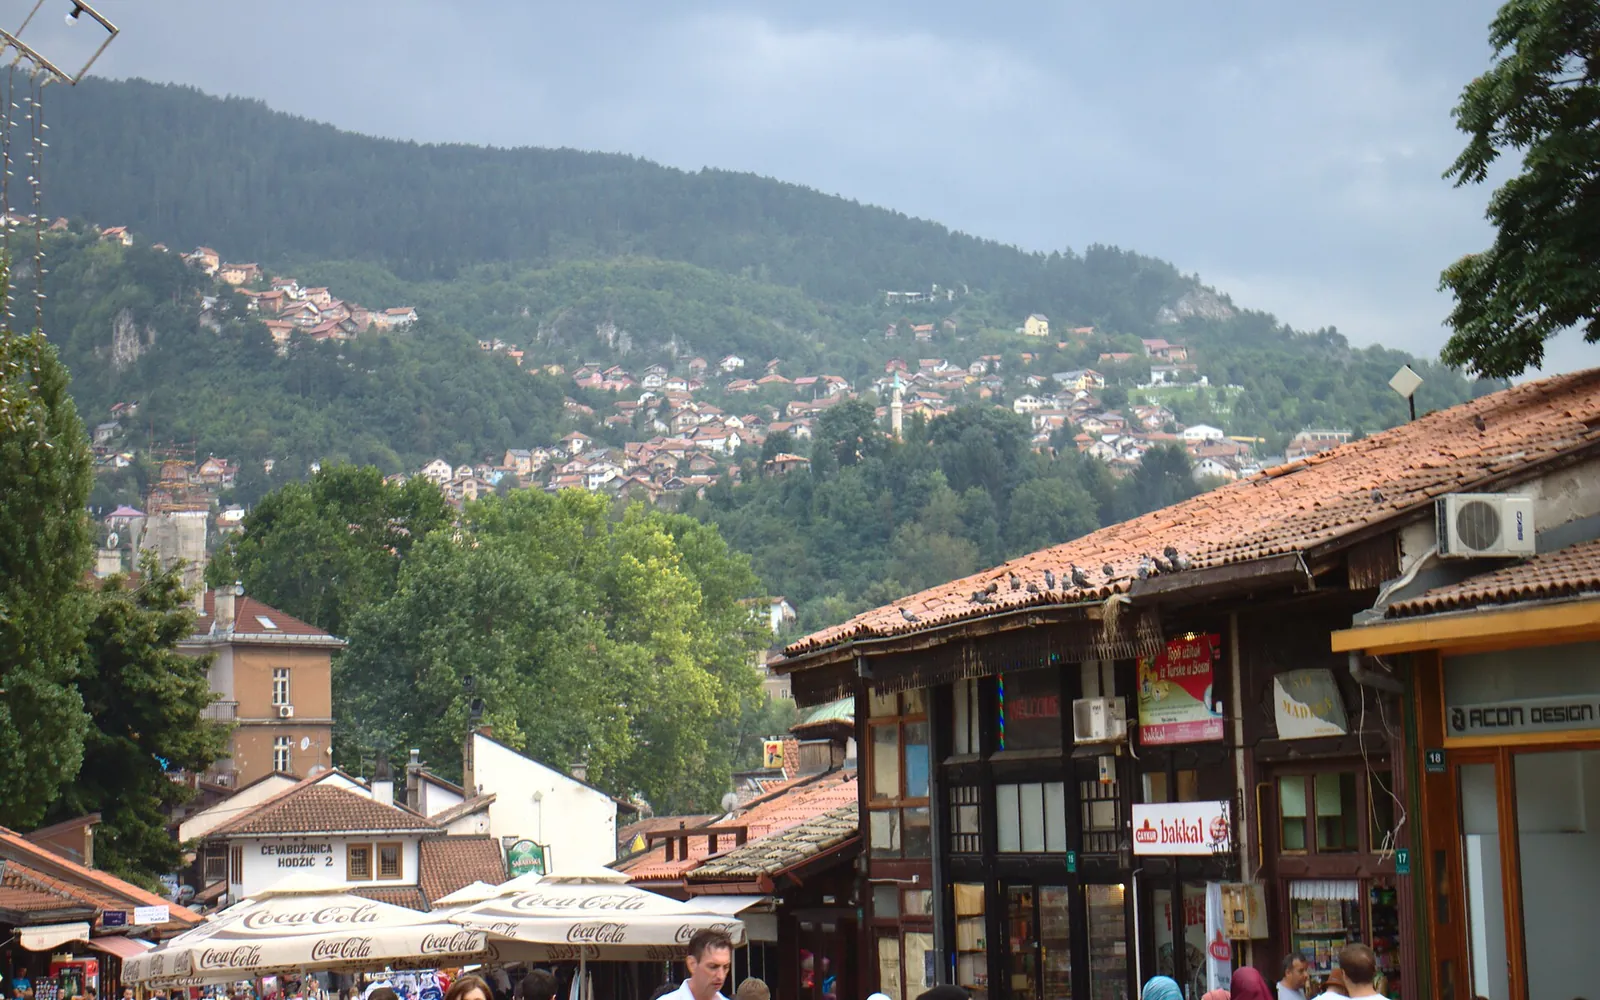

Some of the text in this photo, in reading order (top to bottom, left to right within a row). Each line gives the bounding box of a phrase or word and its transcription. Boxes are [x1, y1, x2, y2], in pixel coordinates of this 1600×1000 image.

[1167, 663, 1186, 677] Turske
[1192, 659, 1210, 675] Bosni
[1531, 704, 1593, 724] DESIGN
[1430, 753, 1441, 763] 18
[1160, 817, 1204, 843] bakkal
[278, 855, 333, 867] HODŽIĆ 2
[1398, 852, 1406, 864] 17
[243, 904, 380, 929] Coca-Cola
[421, 930, 480, 953] Coca-Cola
[566, 923, 628, 943] Coca-Cola
[200, 945, 263, 969] Coca-Cola
[311, 936, 373, 961] Coca-Cola
